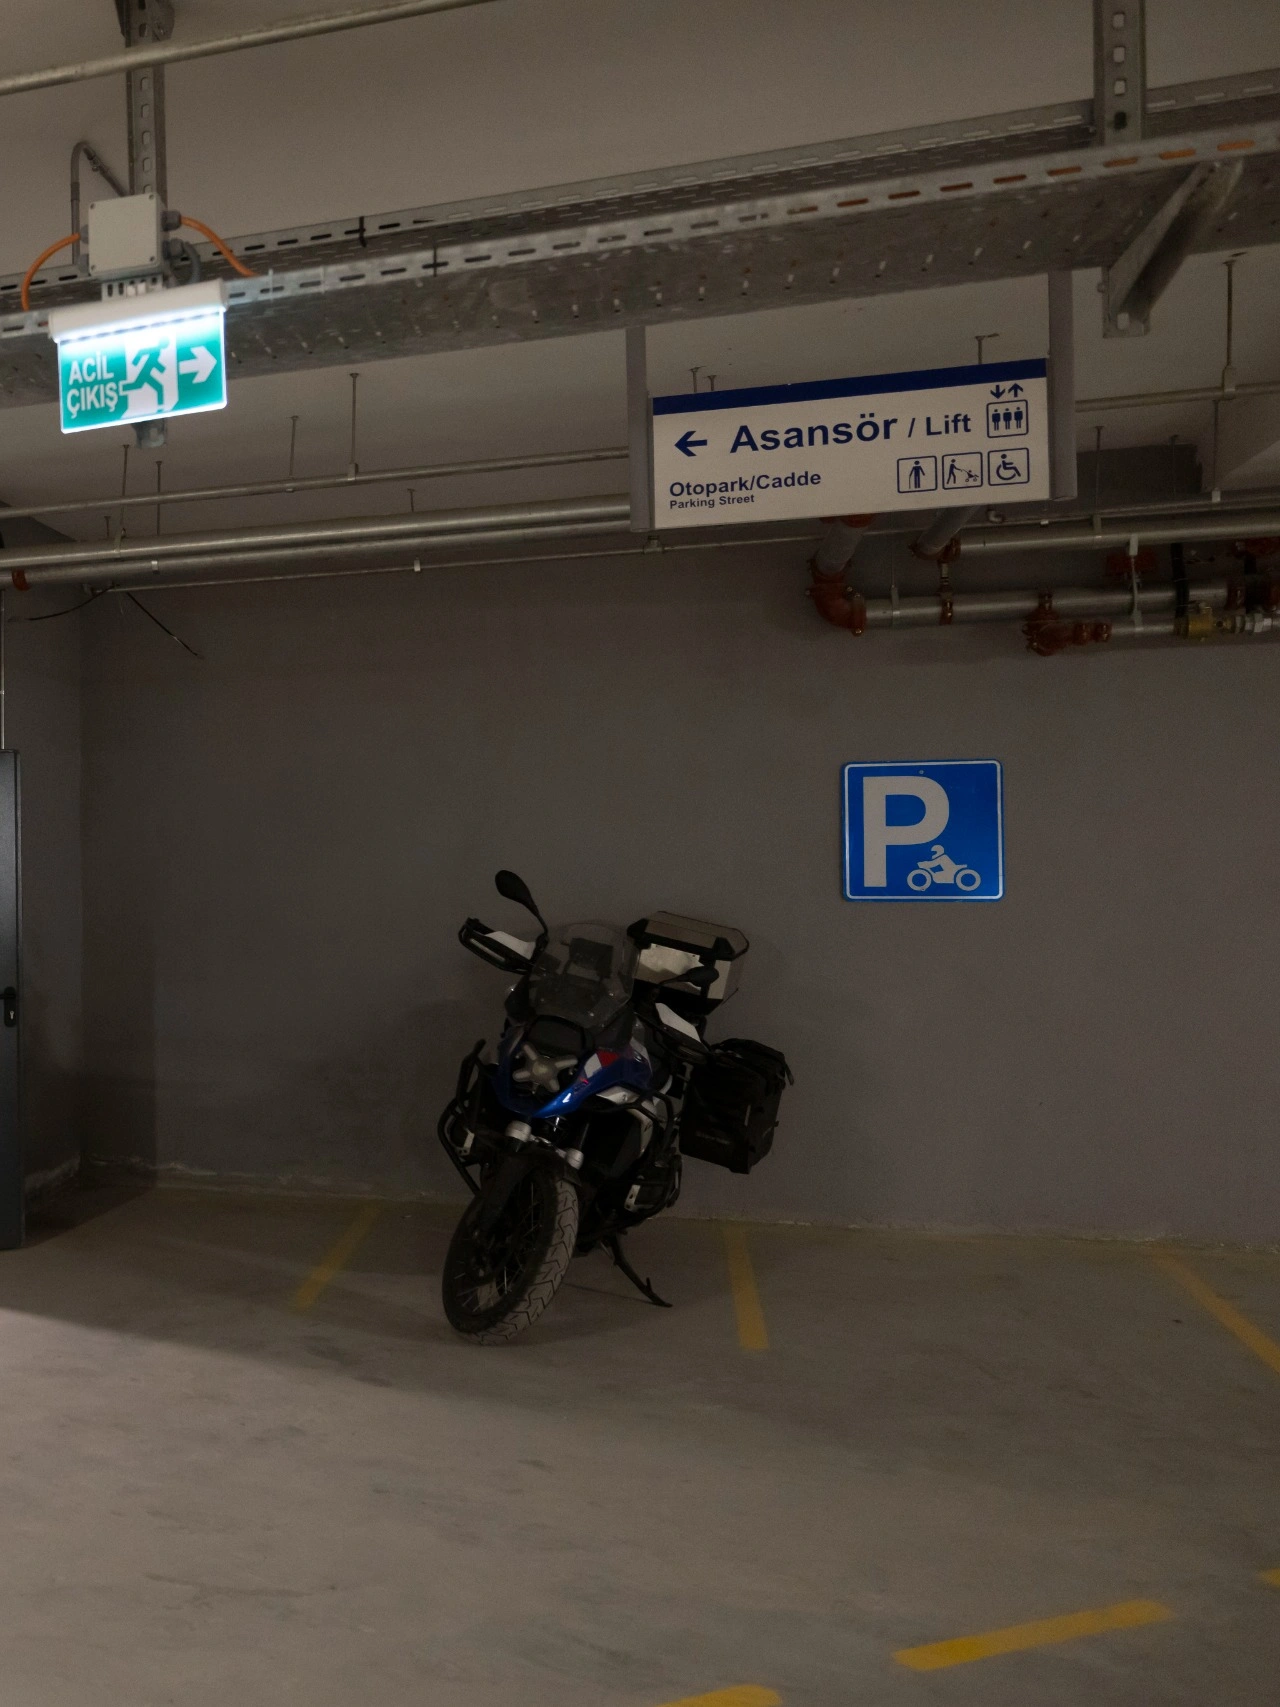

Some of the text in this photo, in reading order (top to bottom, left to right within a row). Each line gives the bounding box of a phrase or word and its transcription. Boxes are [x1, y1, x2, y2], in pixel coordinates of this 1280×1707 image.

[69, 351, 114, 385] ACİL
[67, 382, 118, 419] ÇIKIŞ
[729, 412, 898, 453] Asansör
[926, 413, 972, 436] Lift
[669, 471, 821, 499] Otopark/Cadde
[669, 494, 755, 510] Parking Street
[863, 776, 949, 887] P
